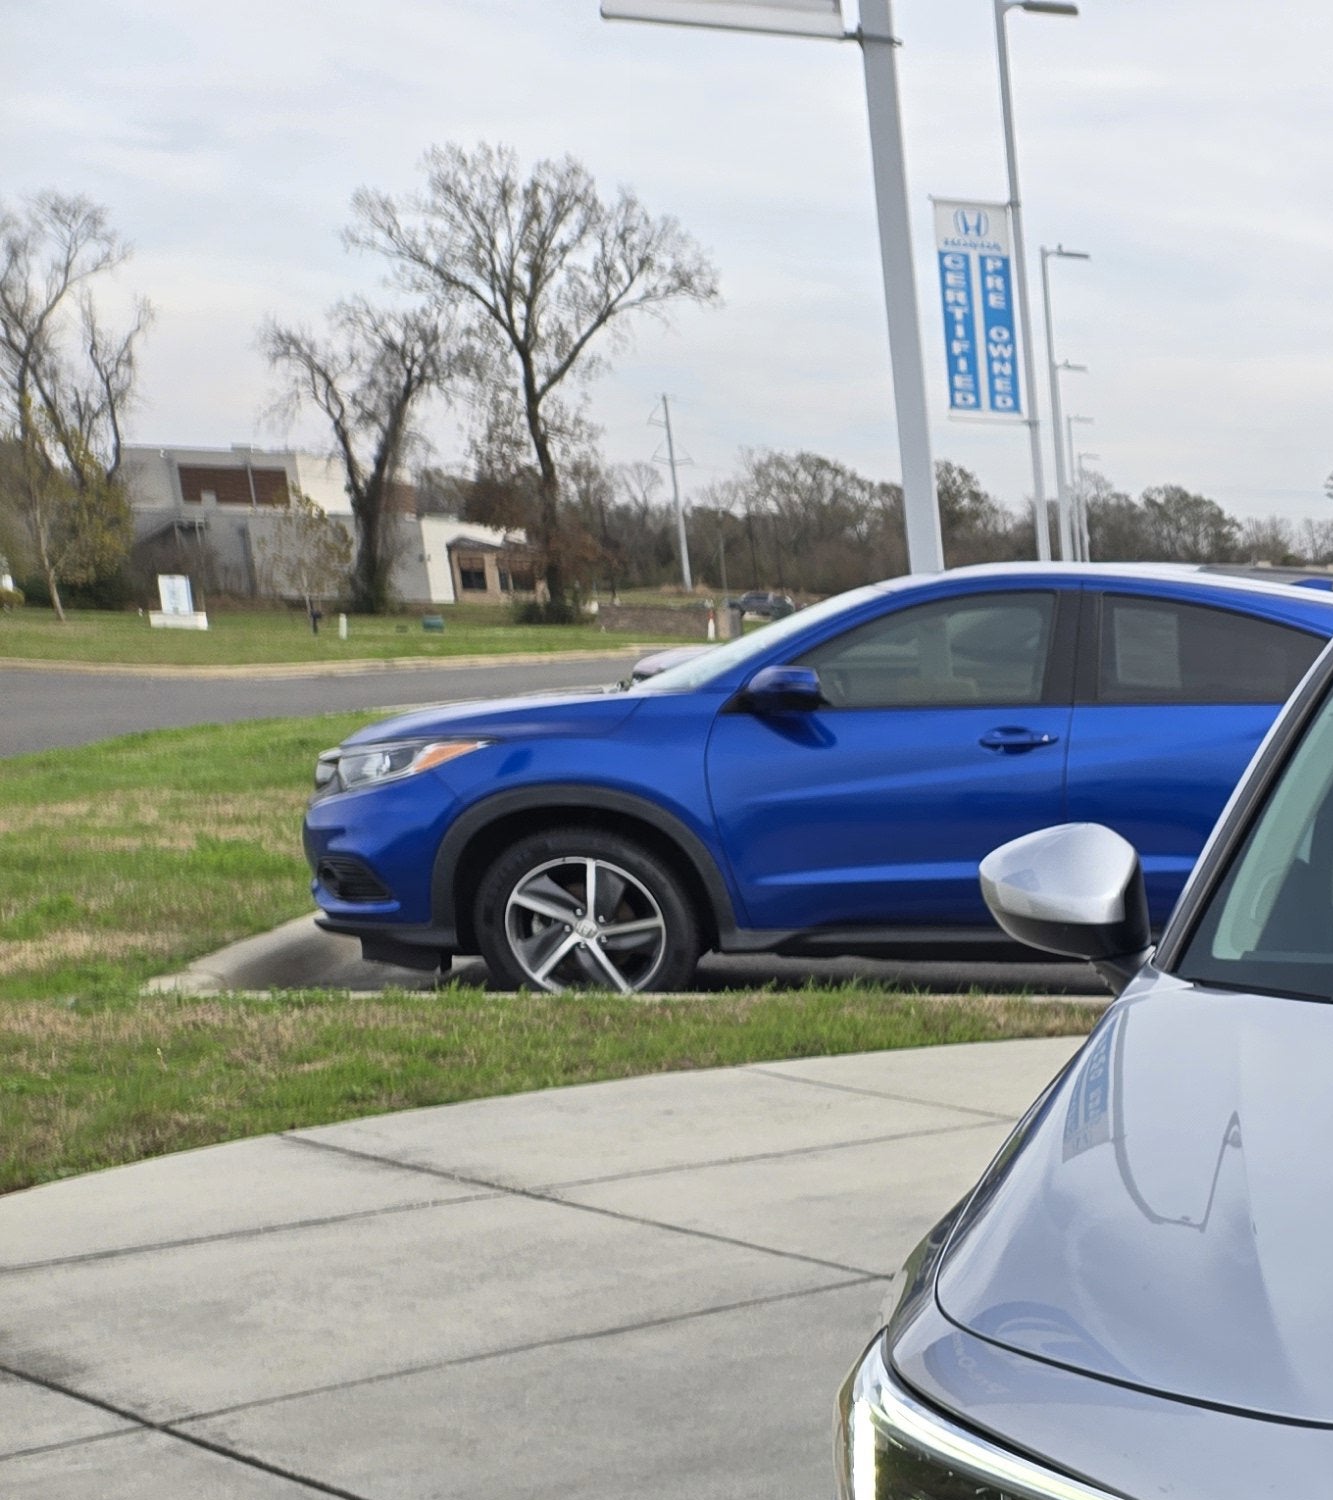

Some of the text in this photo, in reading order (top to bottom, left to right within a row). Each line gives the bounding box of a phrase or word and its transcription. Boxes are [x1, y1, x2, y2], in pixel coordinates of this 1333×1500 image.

[942, 253, 977, 407] CERTIFIED
[985, 256, 1014, 410] PRE OWNED
